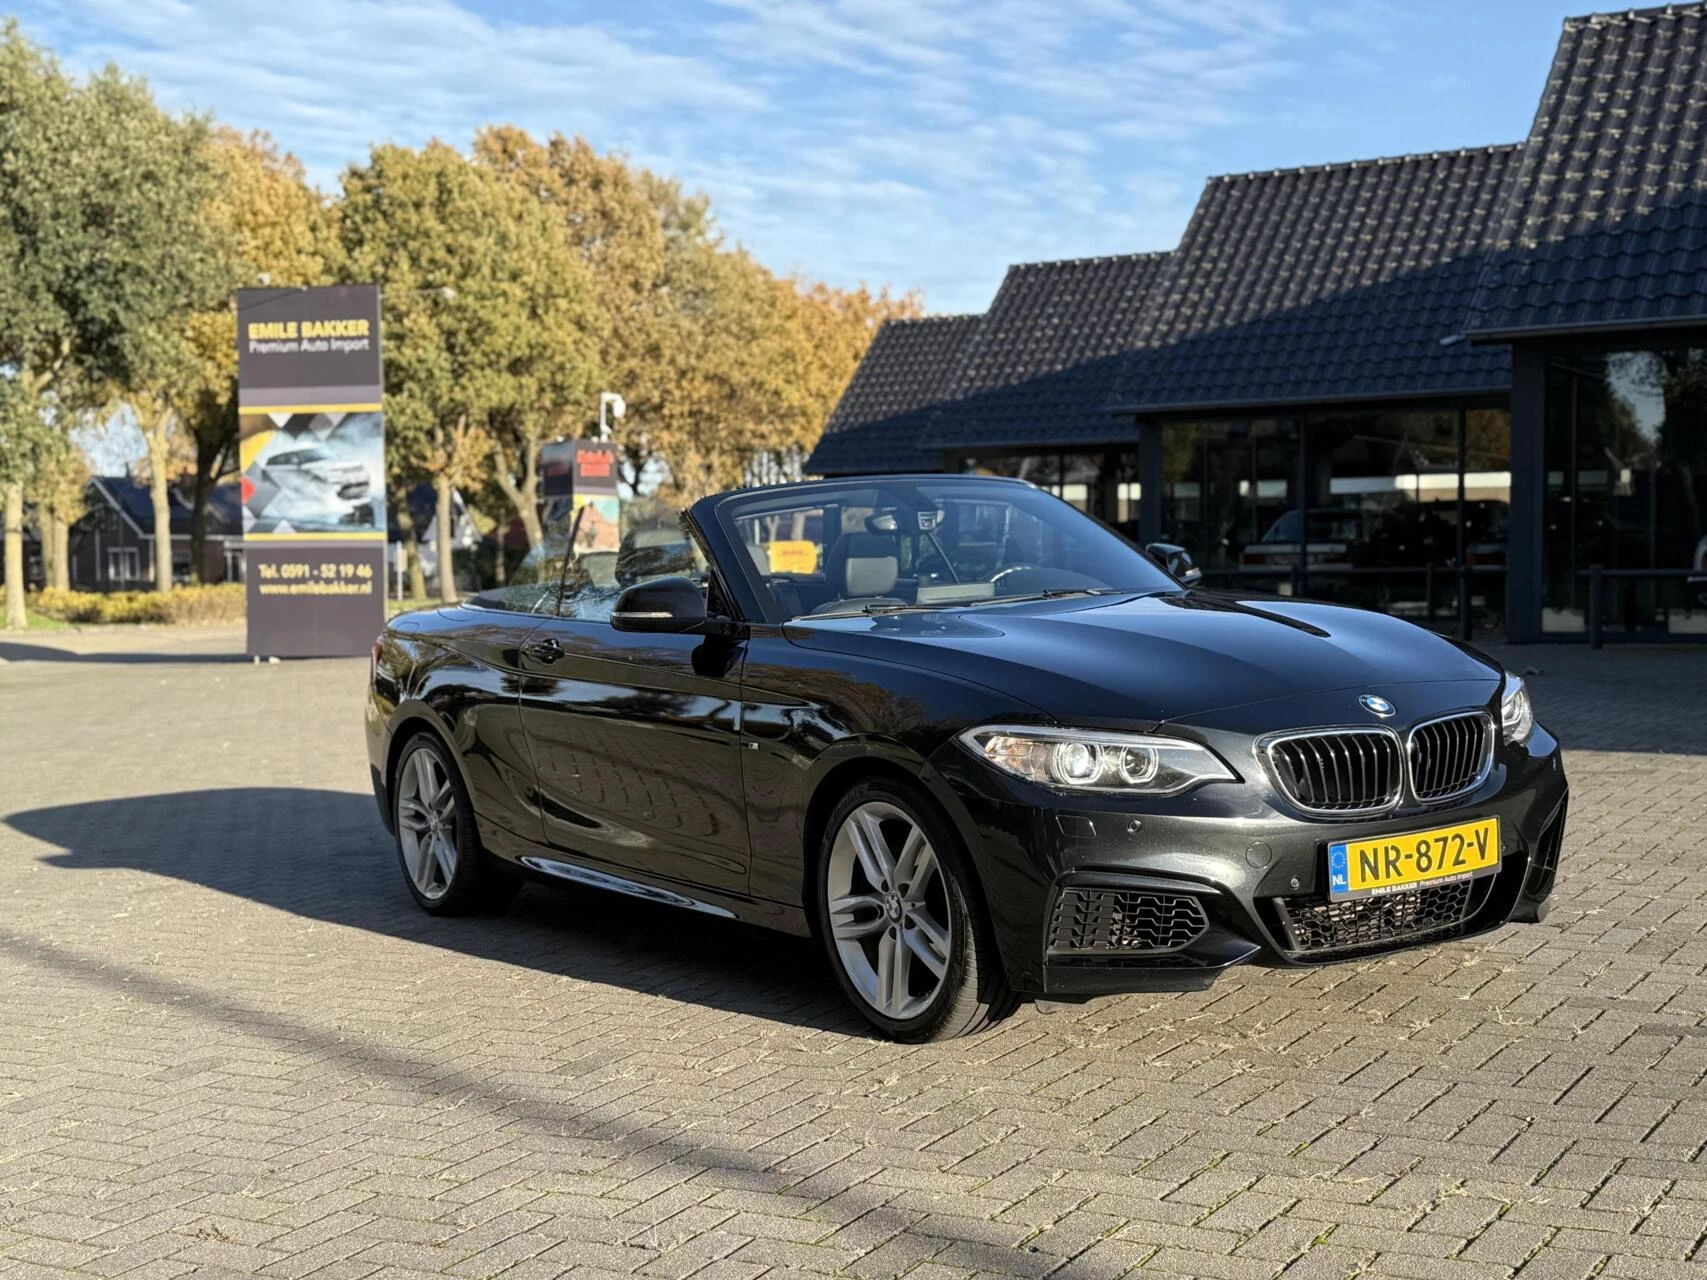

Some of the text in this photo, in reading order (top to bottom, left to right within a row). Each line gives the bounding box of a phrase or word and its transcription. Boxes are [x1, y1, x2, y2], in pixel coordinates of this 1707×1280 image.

[248, 319, 369, 339] EMILE BAKKER
[249, 338, 369, 354] Premium Auto Import
[258, 564, 278, 578] Tel.
[281, 564, 310, 578] 0591
[320, 563, 337, 578] 52
[339, 563, 354, 578] 19
[356, 563, 373, 578] 46
[1359, 827, 1489, 883] NR-872-V
[1332, 874, 1346, 886] NL
[1371, 871, 1473, 896] EMILE BAKKER Premium Auto Import
